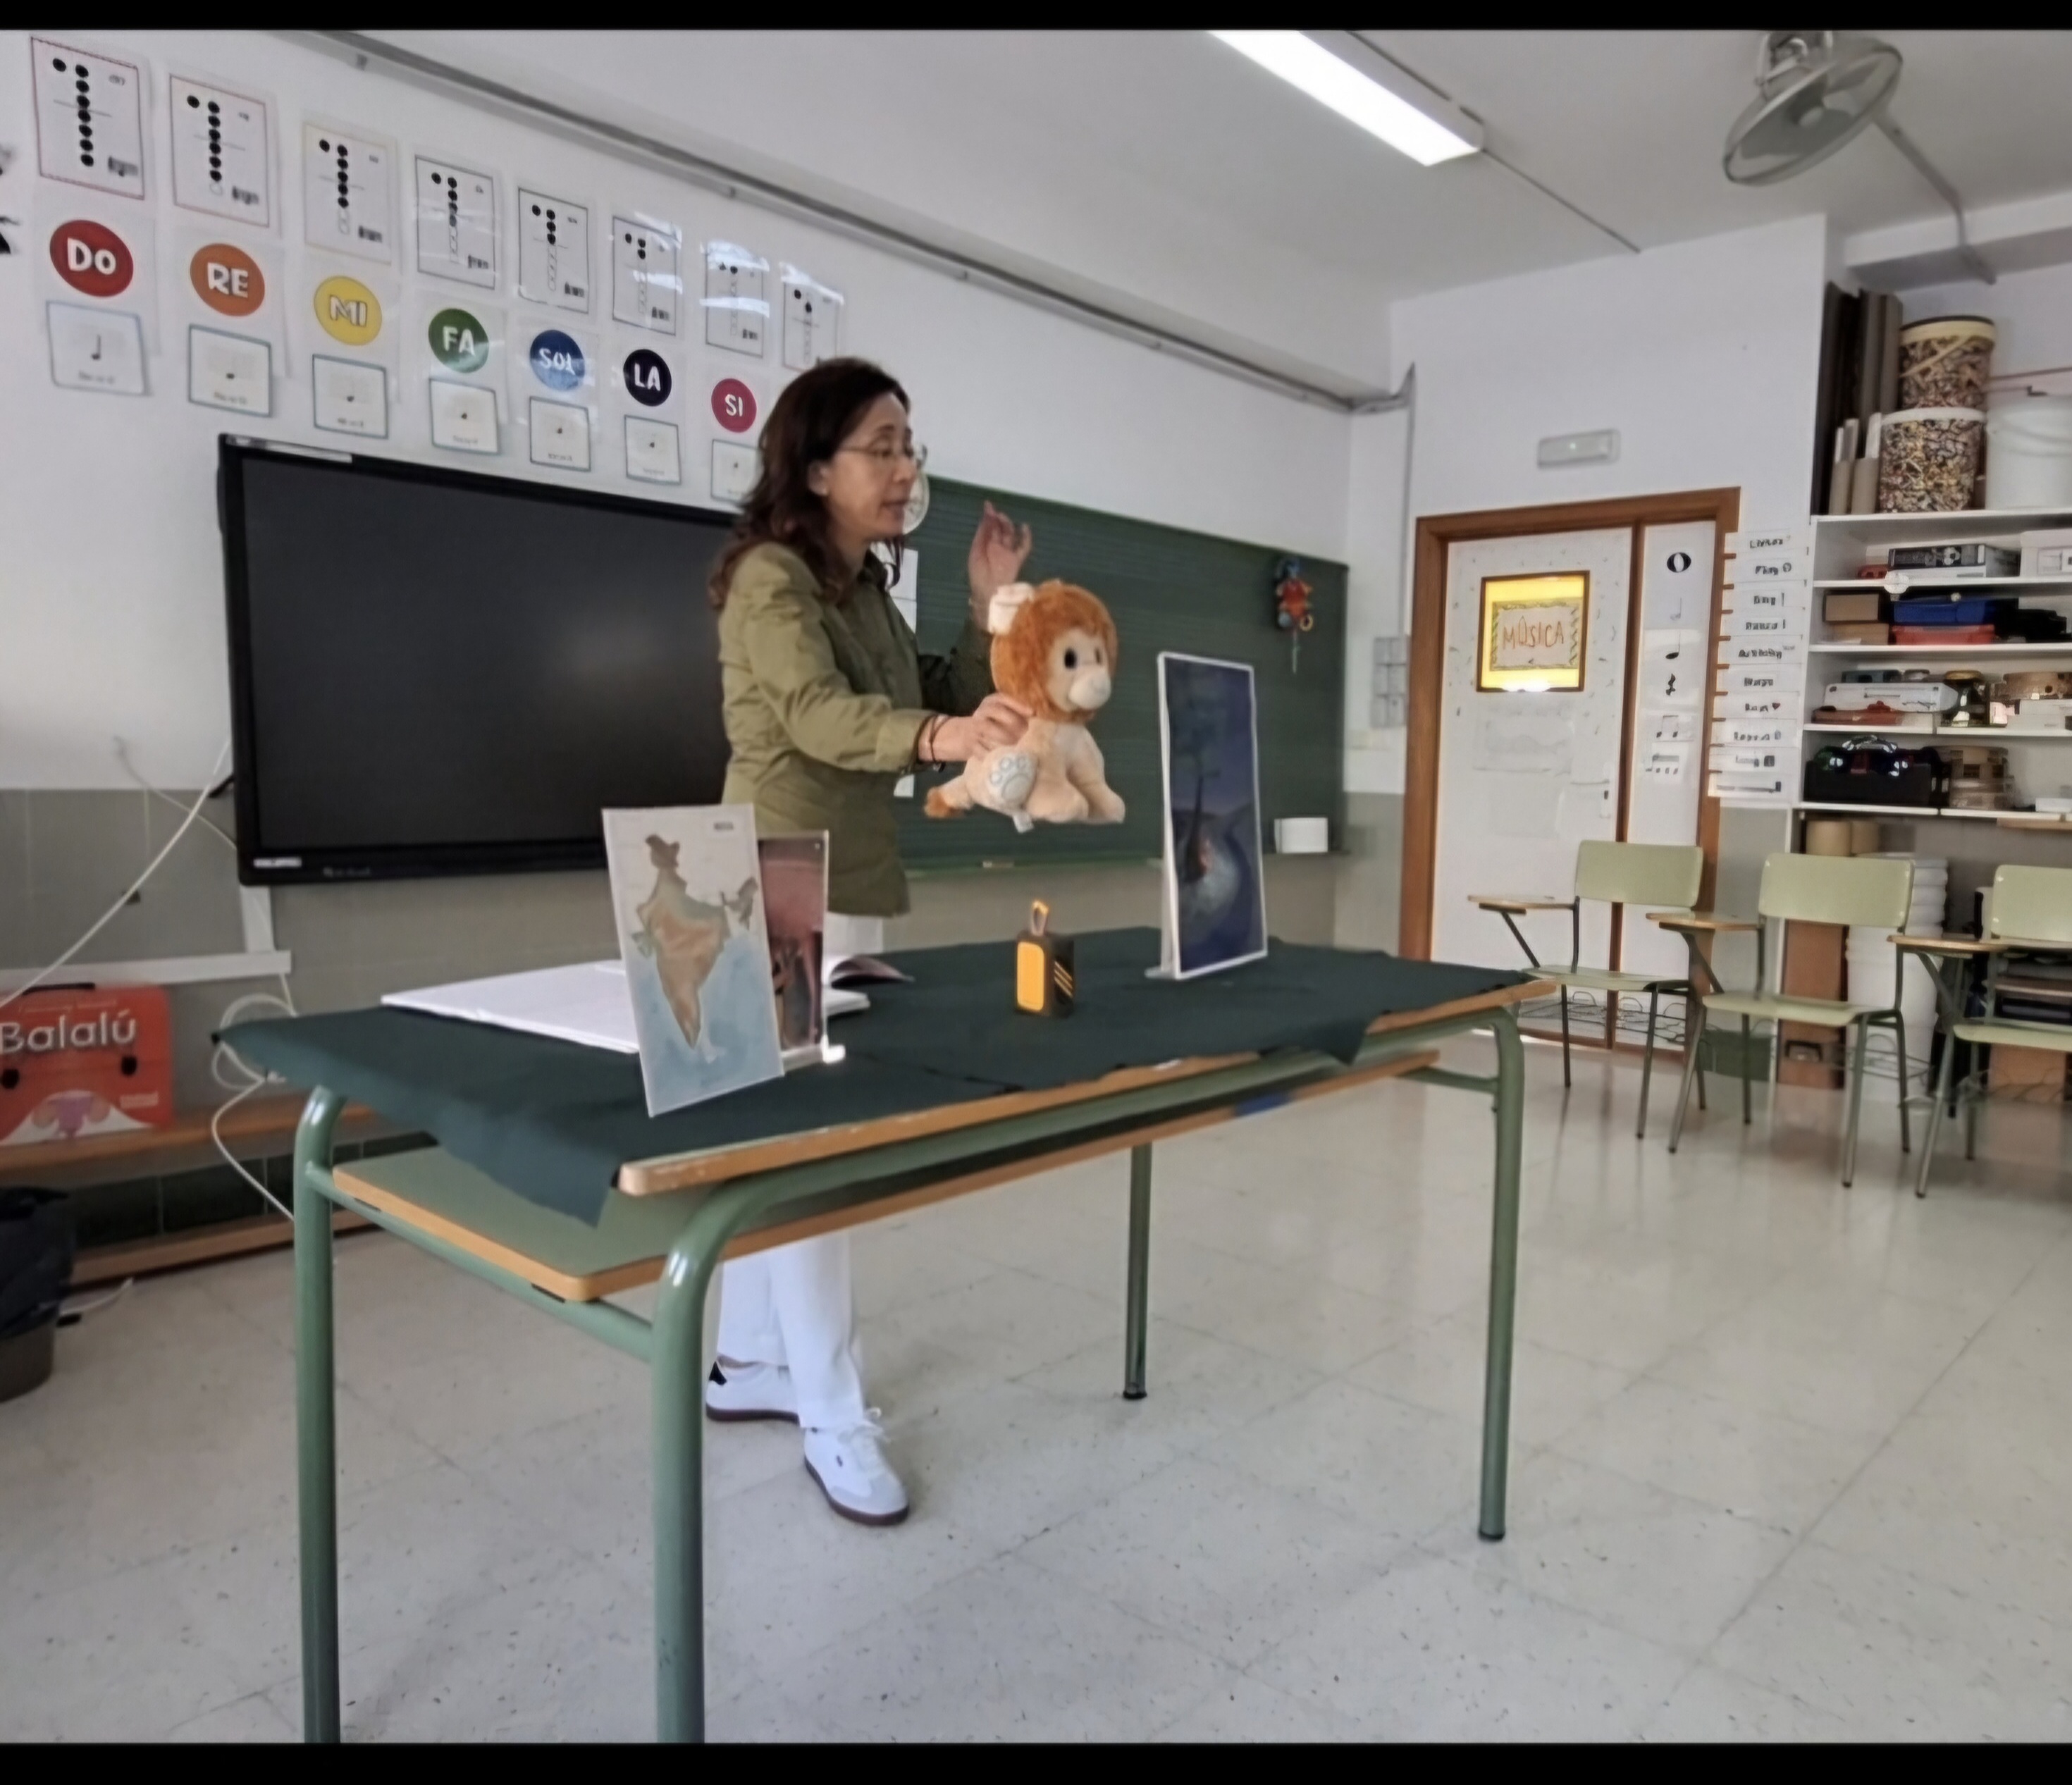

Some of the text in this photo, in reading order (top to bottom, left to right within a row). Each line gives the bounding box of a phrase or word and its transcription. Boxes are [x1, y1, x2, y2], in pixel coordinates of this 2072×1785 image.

[207, 262, 249, 298] RE
[328, 295, 368, 327] MI
[442, 326, 476, 356] FA
[634, 364, 661, 392] LA
[724, 394, 744, 417] SI
[0, 1009, 137, 1054] Balalú
